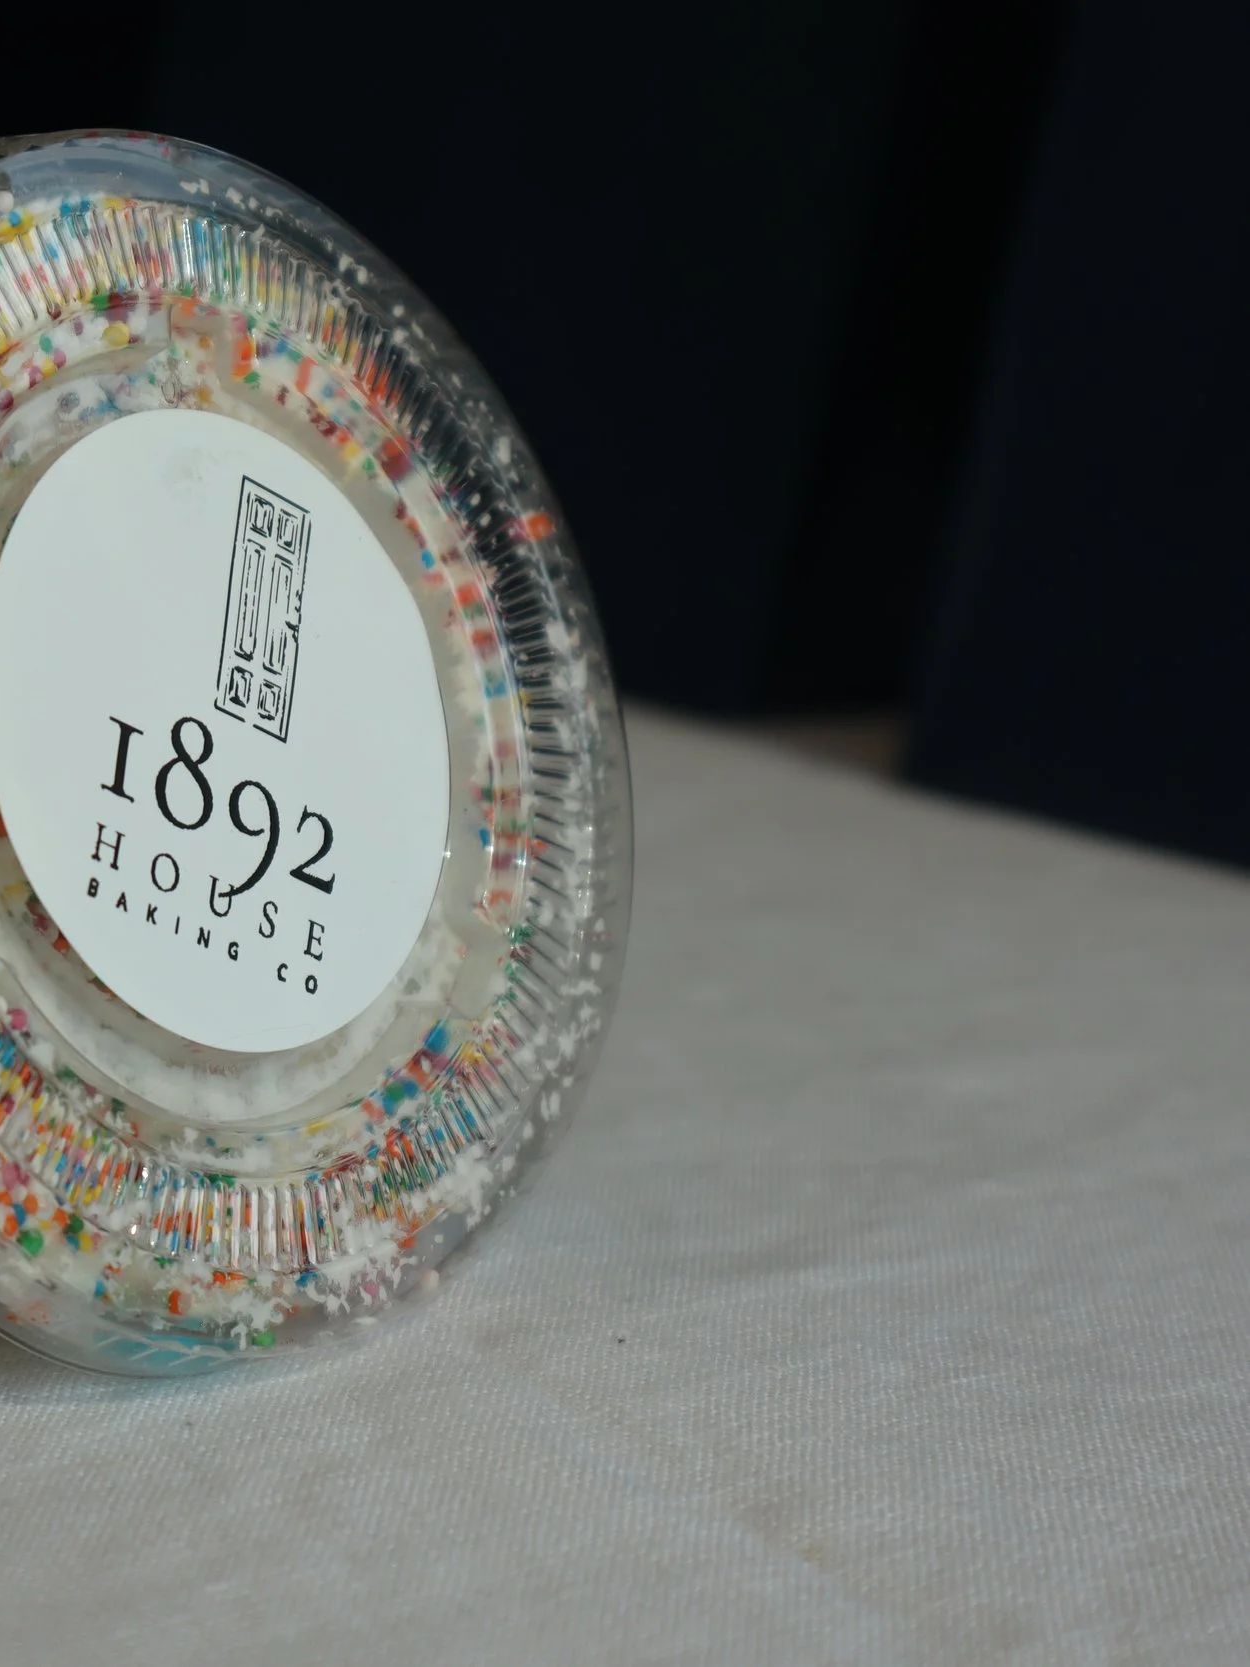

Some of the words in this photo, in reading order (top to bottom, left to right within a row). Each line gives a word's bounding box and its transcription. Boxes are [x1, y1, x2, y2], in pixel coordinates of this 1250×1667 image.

[100, 716, 336, 898] 1892
[87, 877, 240, 962] BAKING
[276, 962, 319, 995] CO
[91, 822, 325, 962] HOUSE
